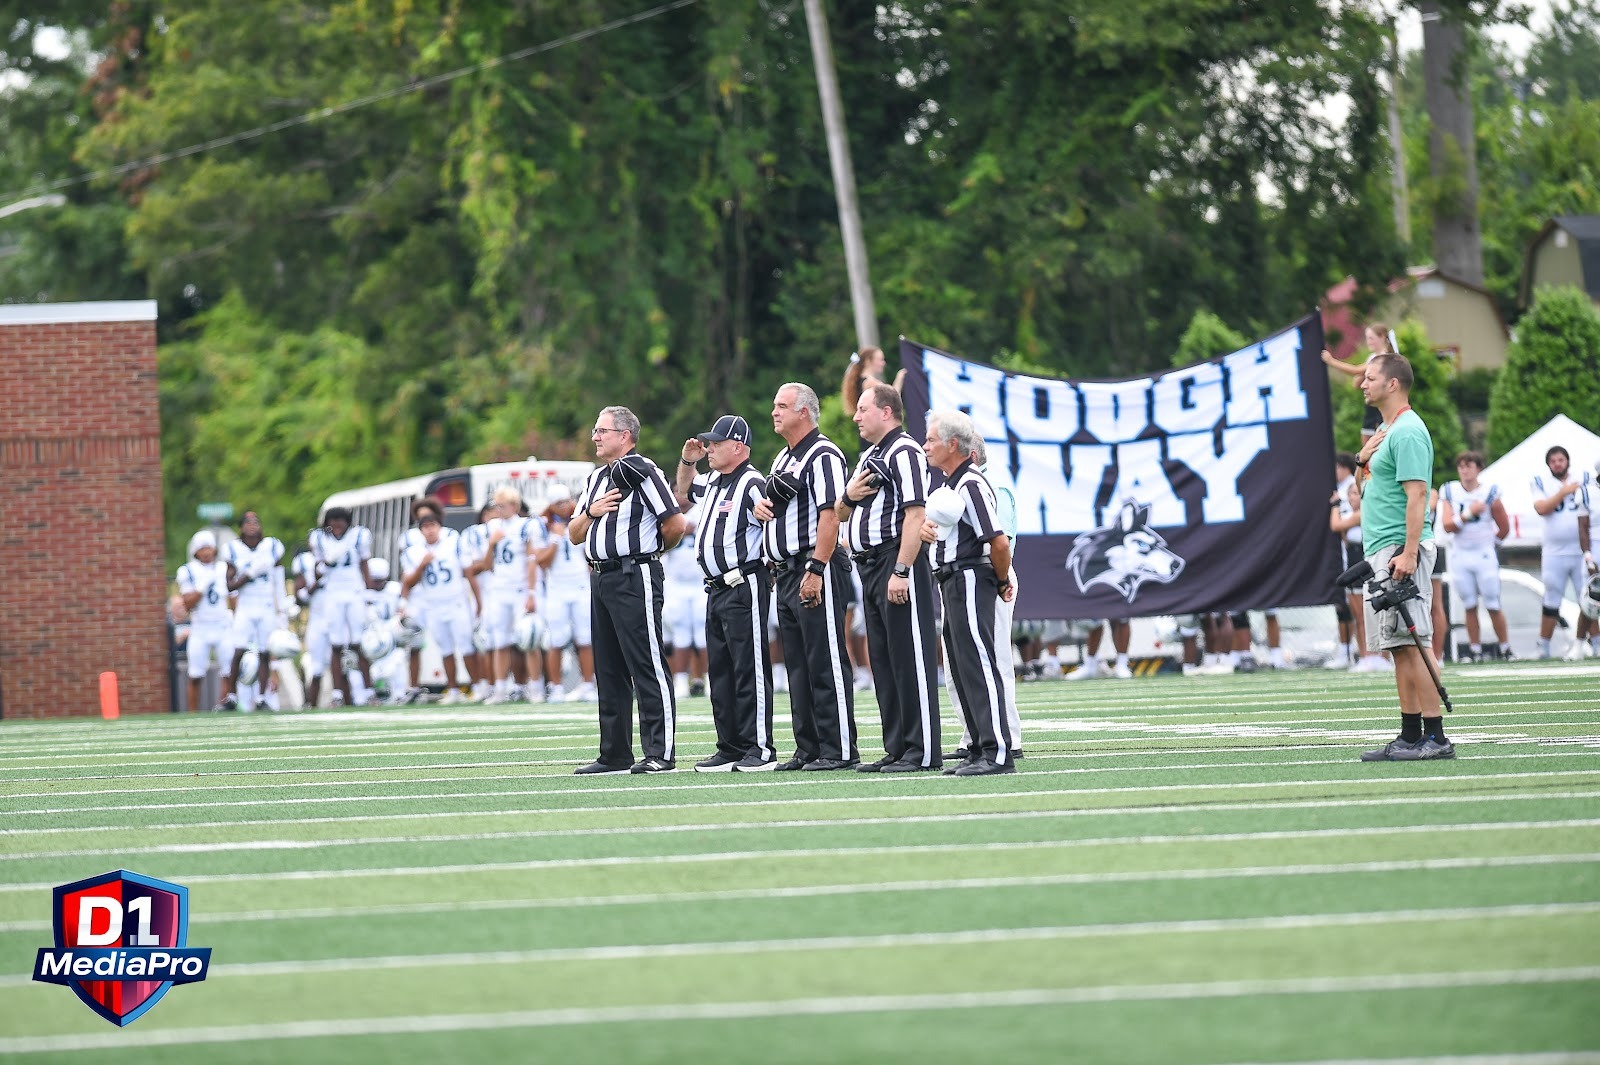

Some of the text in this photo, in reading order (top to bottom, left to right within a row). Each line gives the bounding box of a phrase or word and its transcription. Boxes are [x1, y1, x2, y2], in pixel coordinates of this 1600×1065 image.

[922, 327, 1309, 443] HOUGH
[985, 424, 1270, 535] WAY
[207, 581, 220, 605] 6
[425, 560, 452, 586] 85
